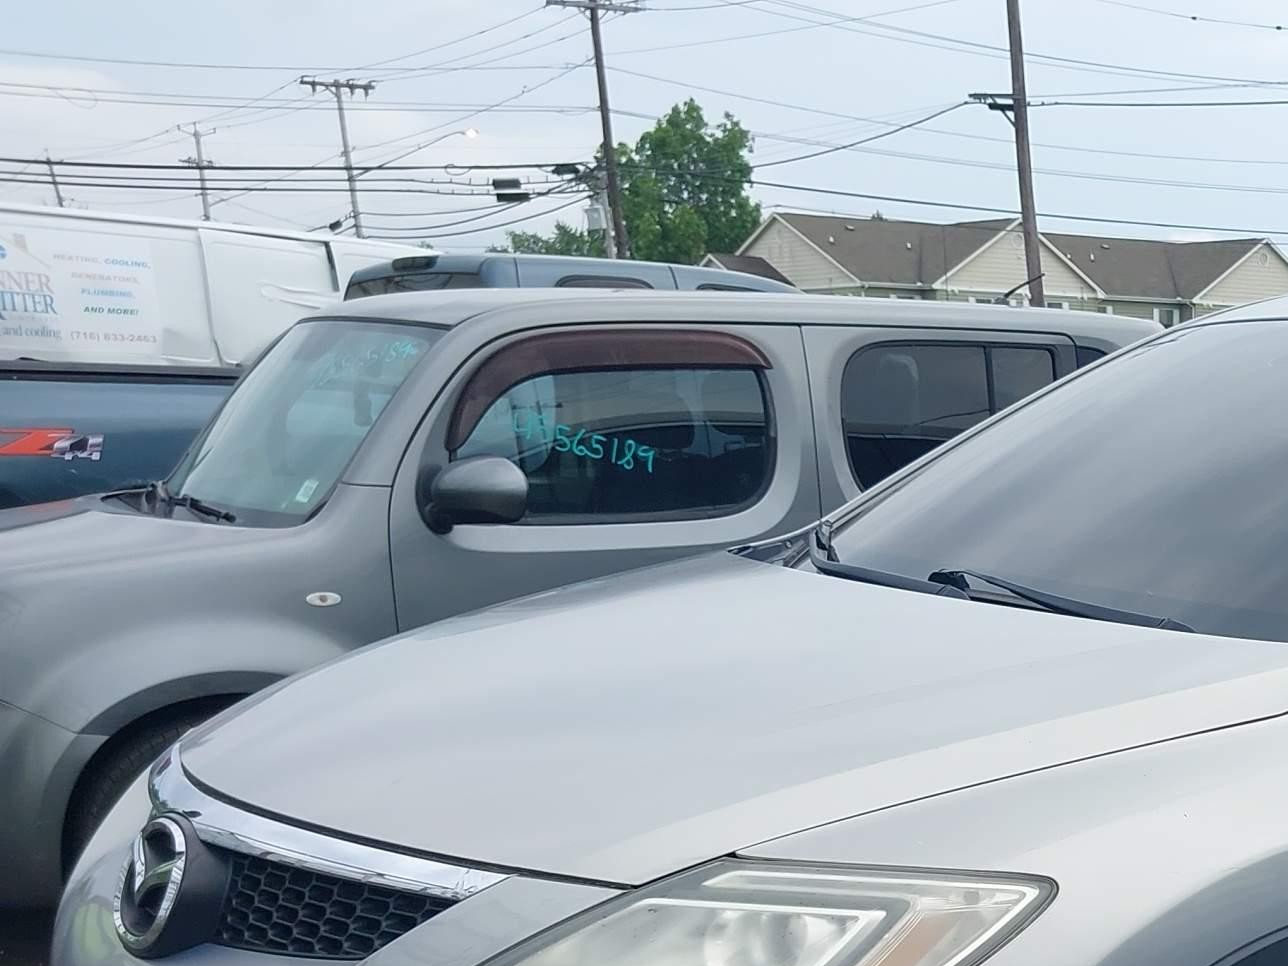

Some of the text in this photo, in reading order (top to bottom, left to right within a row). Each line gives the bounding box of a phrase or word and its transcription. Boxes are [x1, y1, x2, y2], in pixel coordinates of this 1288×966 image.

[104, 258, 151, 269] COOLING,
[0, 291, 58, 316] ITTER
[83, 306, 139, 316] AND MORE!
[25, 326, 62, 341] cooling
